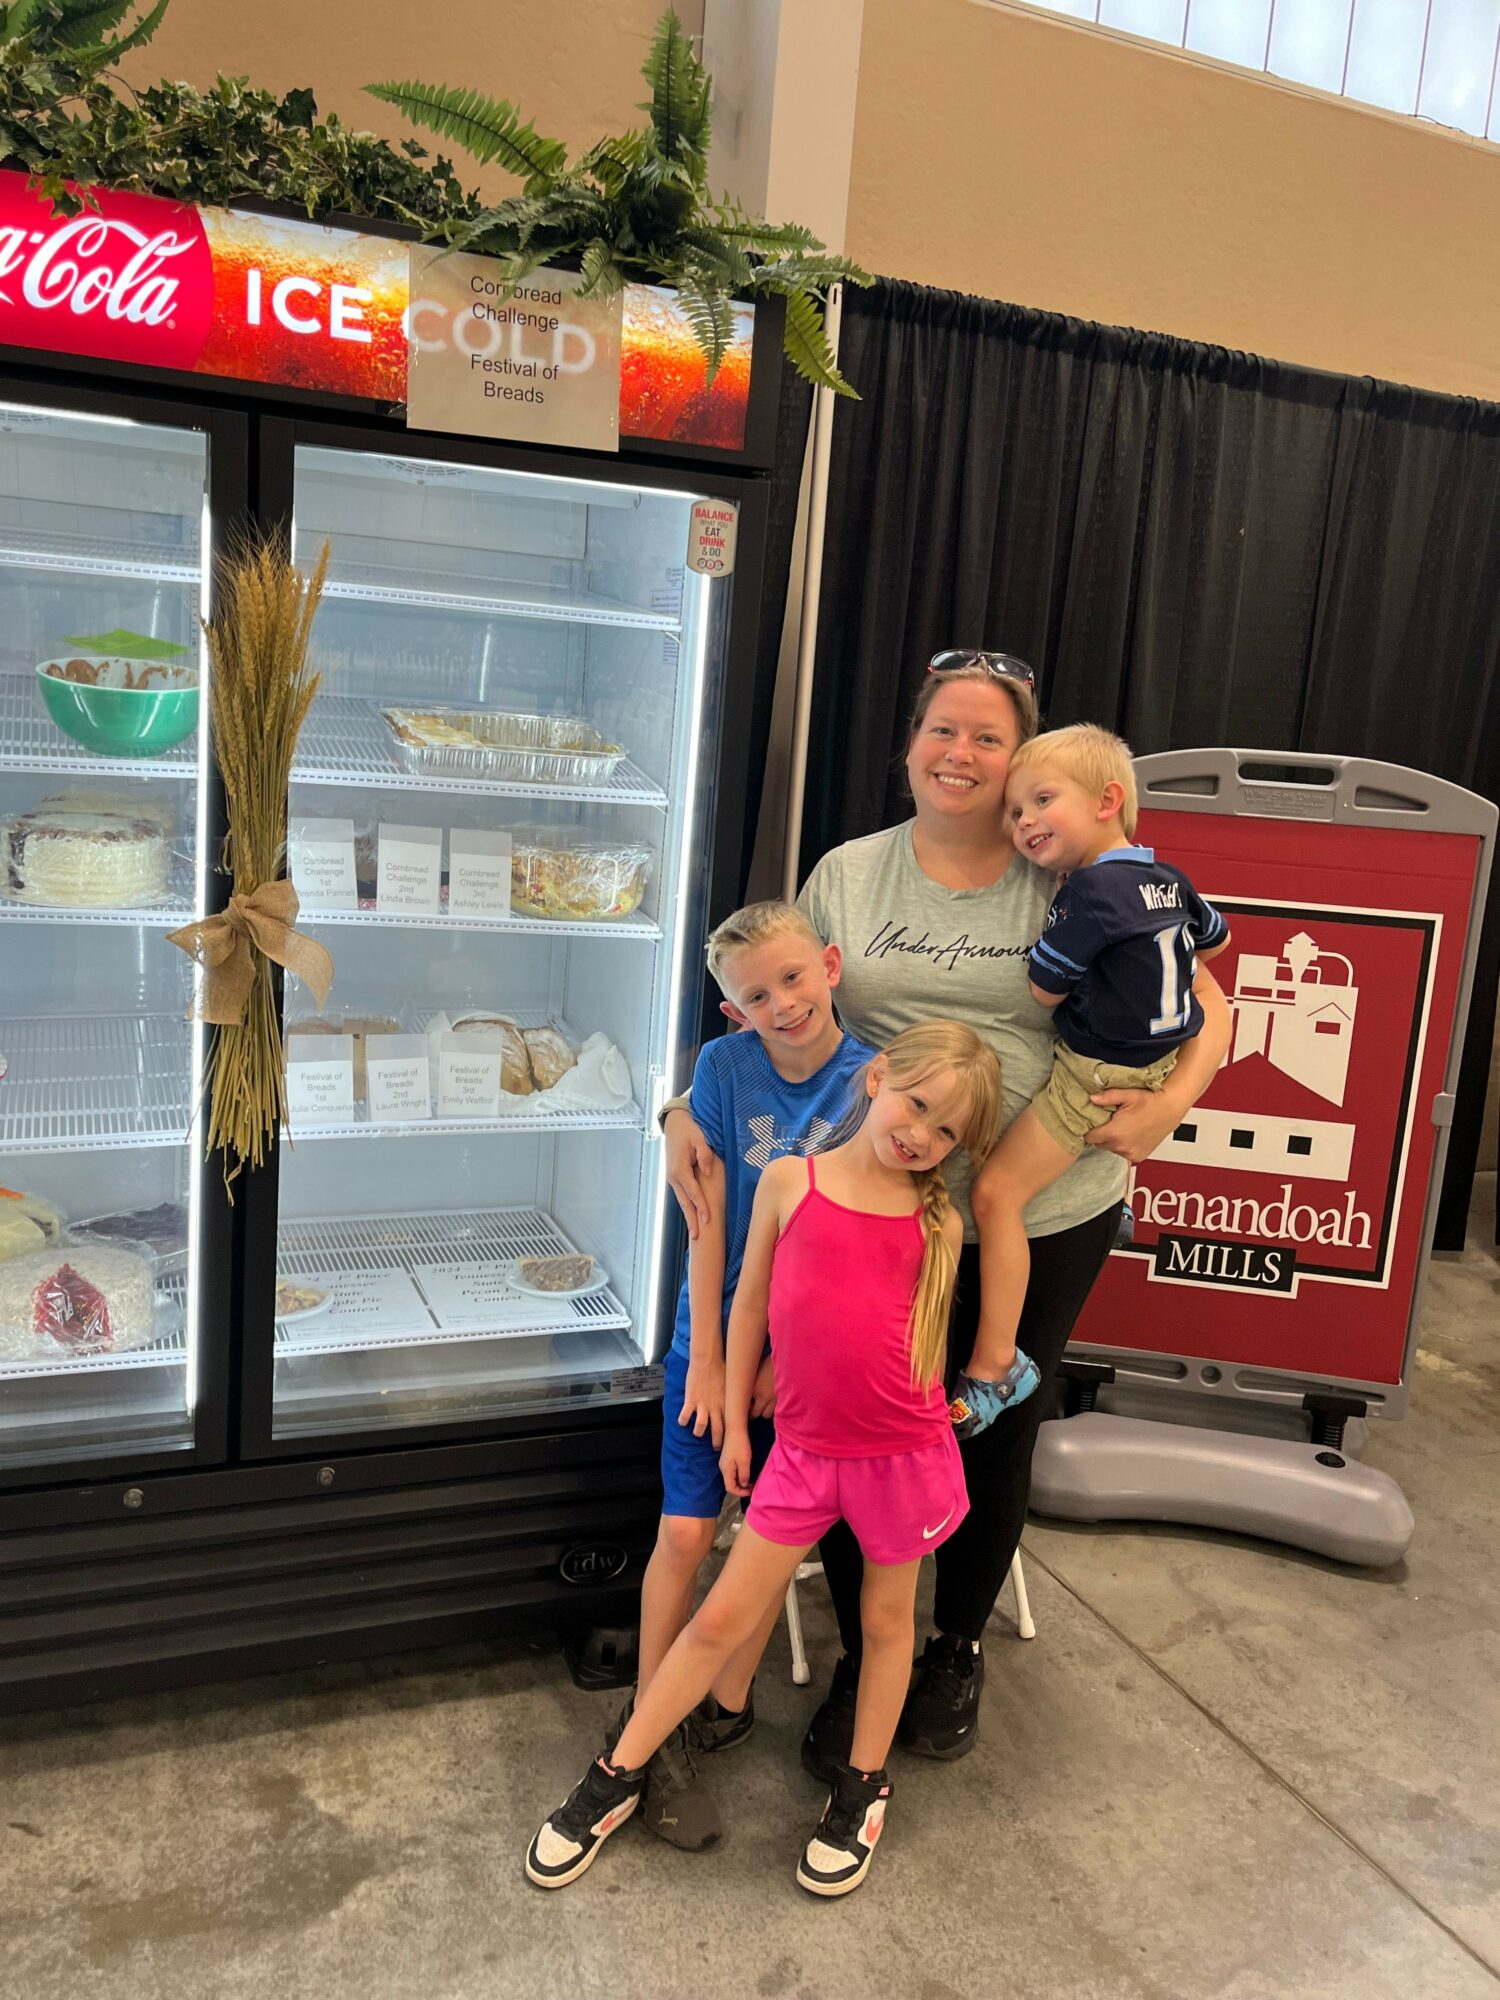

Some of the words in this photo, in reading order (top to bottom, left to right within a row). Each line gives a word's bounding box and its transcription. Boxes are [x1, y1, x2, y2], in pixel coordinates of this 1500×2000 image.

[247, 269, 373, 343] ICE
[402, 299, 597, 374] COLD
[472, 302, 559, 333] Challenge
[471, 353, 537, 378] Festival
[542, 364, 560, 380] of
[484, 381, 544, 404] Breads
[695, 508, 735, 523] BALANCE
[705, 527, 721, 538] EAT
[699, 536, 725, 548] DRINK
[702, 547, 708, 556] &
[709, 547, 721, 557] DO
[303, 857, 345, 866] Cornbread
[304, 868, 345, 878] Challenge
[385, 862, 429, 874] Cornbread
[459, 868, 500, 878] Cornbread
[319, 879, 331, 887] 1st
[386, 873, 428, 885] Challenge
[460, 879, 499, 889] Challenge
[398, 885, 414, 893] 2nd
[473, 889, 486, 898] 3rd
[381, 893, 404, 903] Linda
[405, 895, 431, 905] Brown
[453, 899, 480, 909] Ashley
[482, 900, 504, 909] Lewis
[864, 921, 940, 958] Under
[378, 1070, 409, 1080] Festival
[410, 1068, 419, 1077] of
[449, 1065, 480, 1074] Festival
[481, 1066, 490, 1074] of
[301, 1072, 332, 1081] Festival
[334, 1072, 343, 1080] of
[455, 1076, 483, 1085] Breads
[307, 1083, 336, 1092] Breads
[386, 1080, 414, 1089] Breads
[393, 1090, 408, 1099] 2nd
[462, 1086, 475, 1094] 3rd
[315, 1093, 327, 1101] 1st
[442, 1095, 463, 1105] Emily
[401, 1099, 427, 1109] Wright
[1127, 1165, 1373, 1249] henandoah
[1166, 1240, 1282, 1284] MILLS
